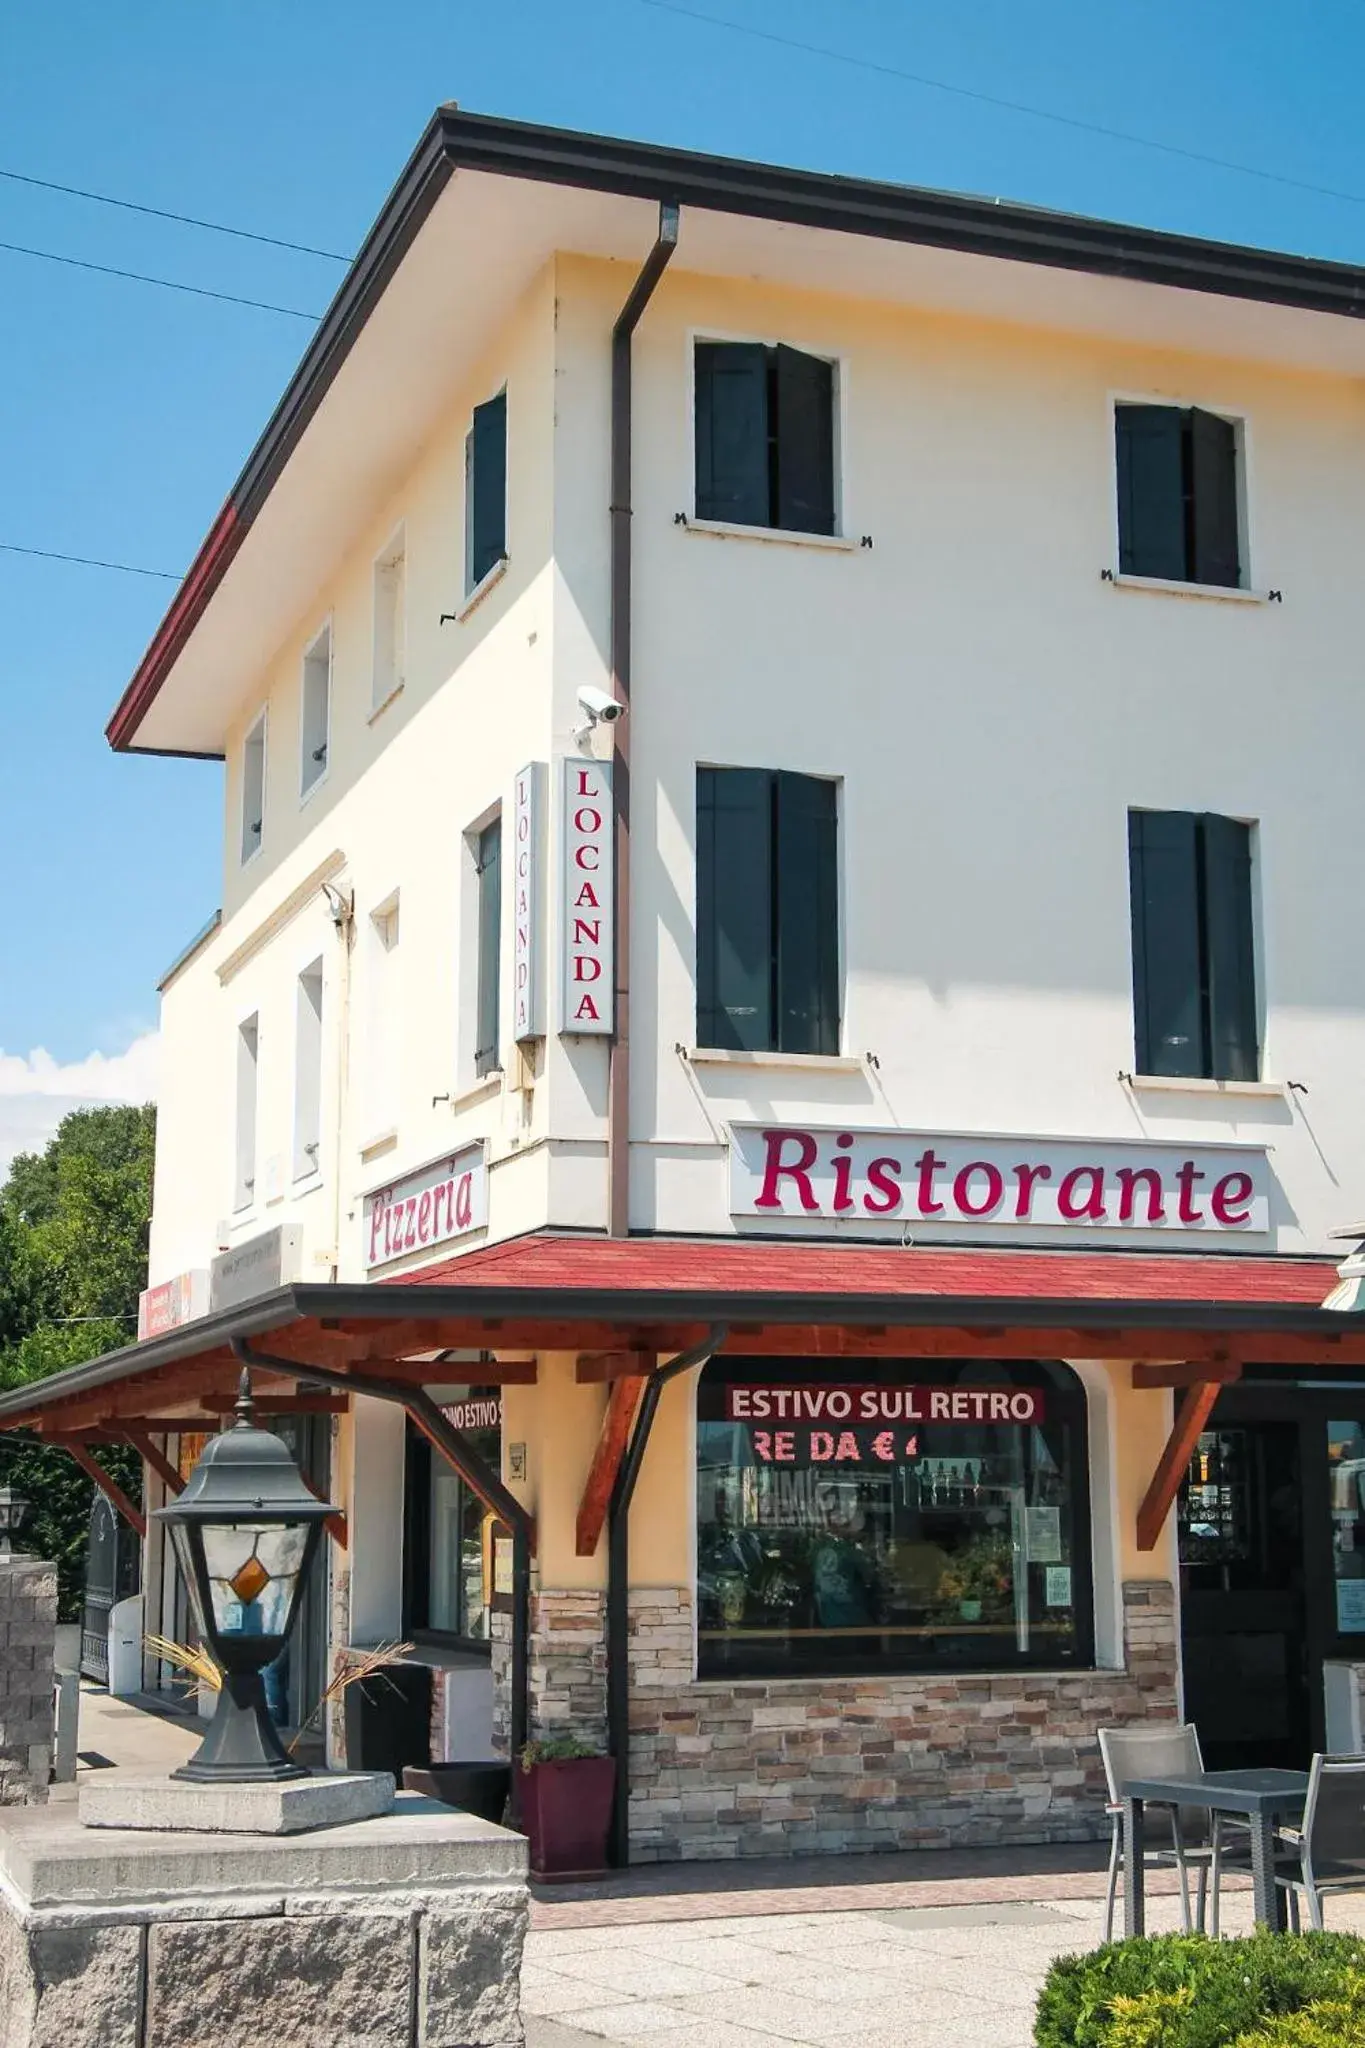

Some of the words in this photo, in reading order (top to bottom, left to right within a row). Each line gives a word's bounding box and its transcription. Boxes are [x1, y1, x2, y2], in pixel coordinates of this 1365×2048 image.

[518, 781, 528, 1027] LOCANDA
[573, 771, 601, 1020] LOCANDA
[370, 1159, 472, 1263] Pizzeria
[754, 1131, 1254, 1224] Ristorante
[465, 1401, 498, 1428] ESTIVO
[733, 1390, 852, 1418] ESTIVO
[860, 1391, 922, 1419] SUL
[931, 1392, 1034, 1420] RETRO
[810, 1432, 861, 1461] DA
